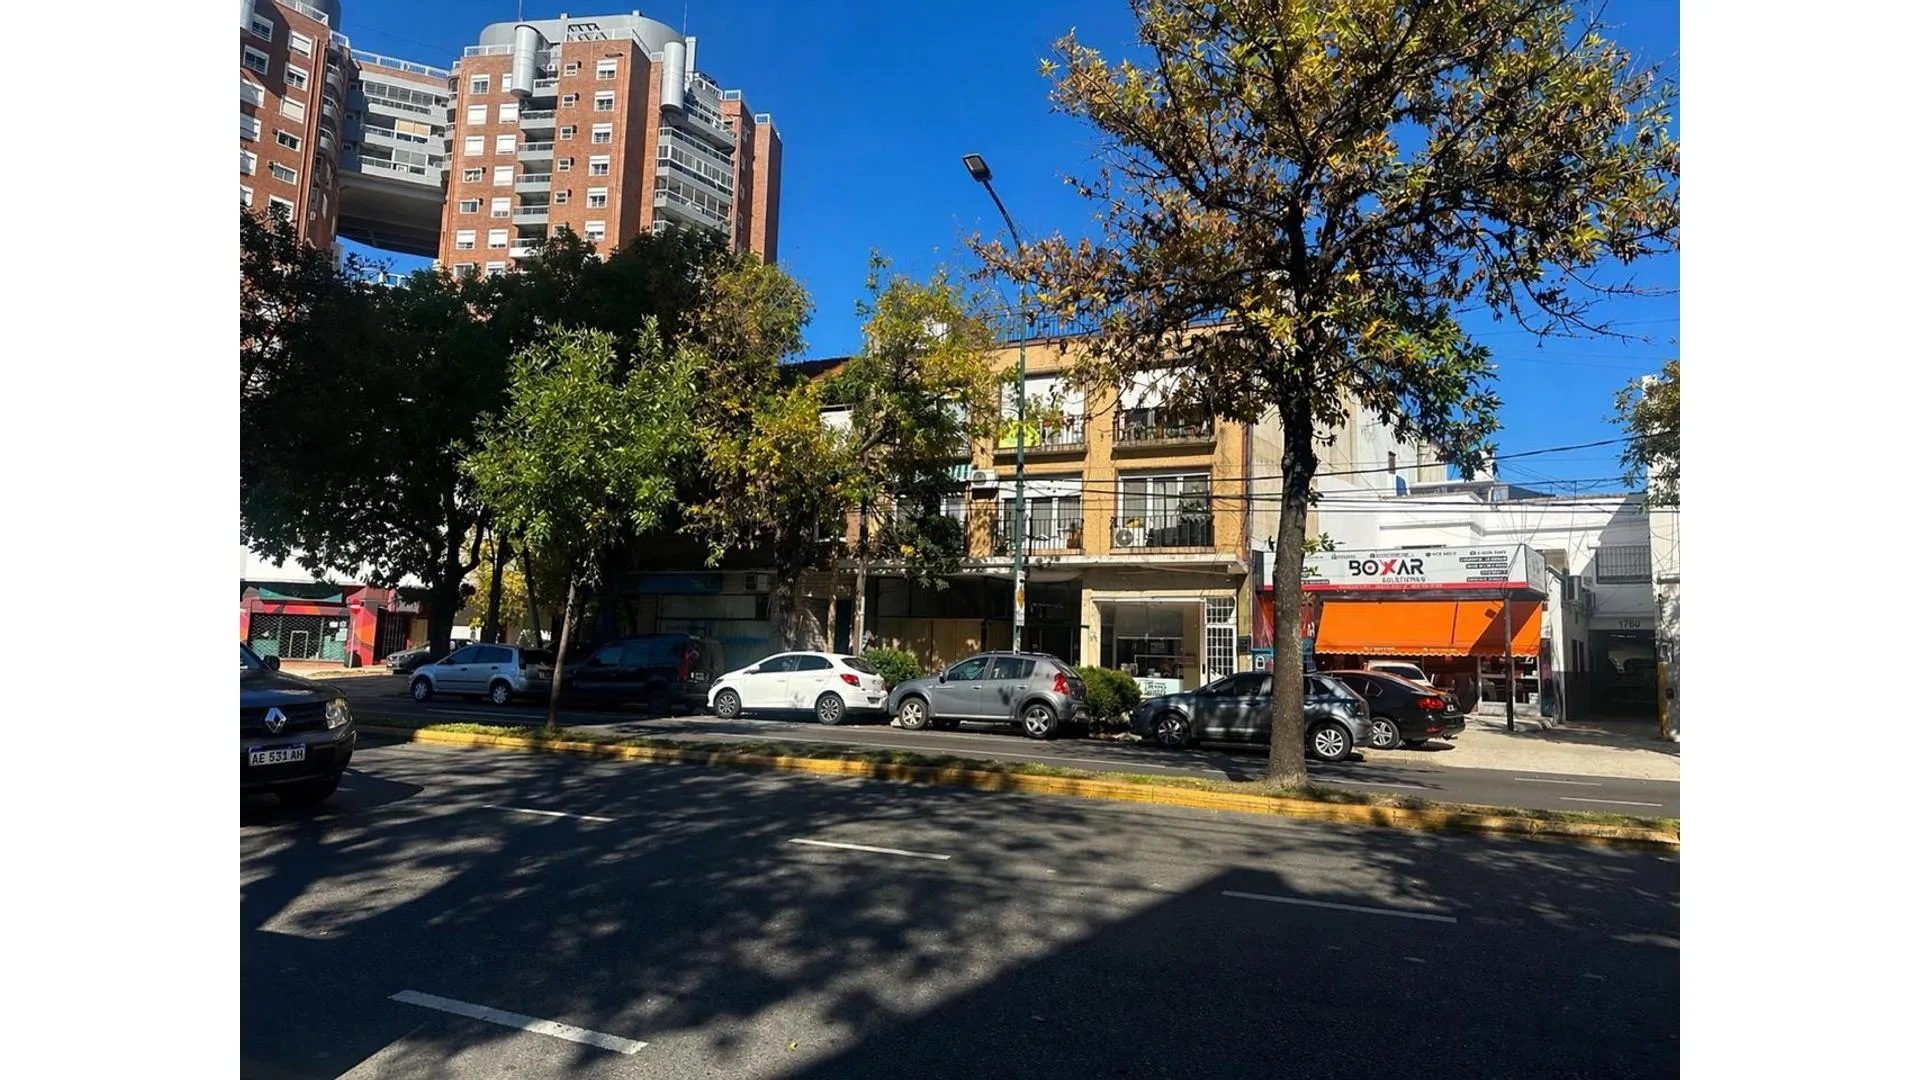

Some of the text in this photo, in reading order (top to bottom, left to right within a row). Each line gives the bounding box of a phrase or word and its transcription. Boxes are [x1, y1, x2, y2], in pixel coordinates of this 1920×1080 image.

[1349, 558, 1424, 576] BOXAR
[252, 749, 303, 764] AE 531 AH
